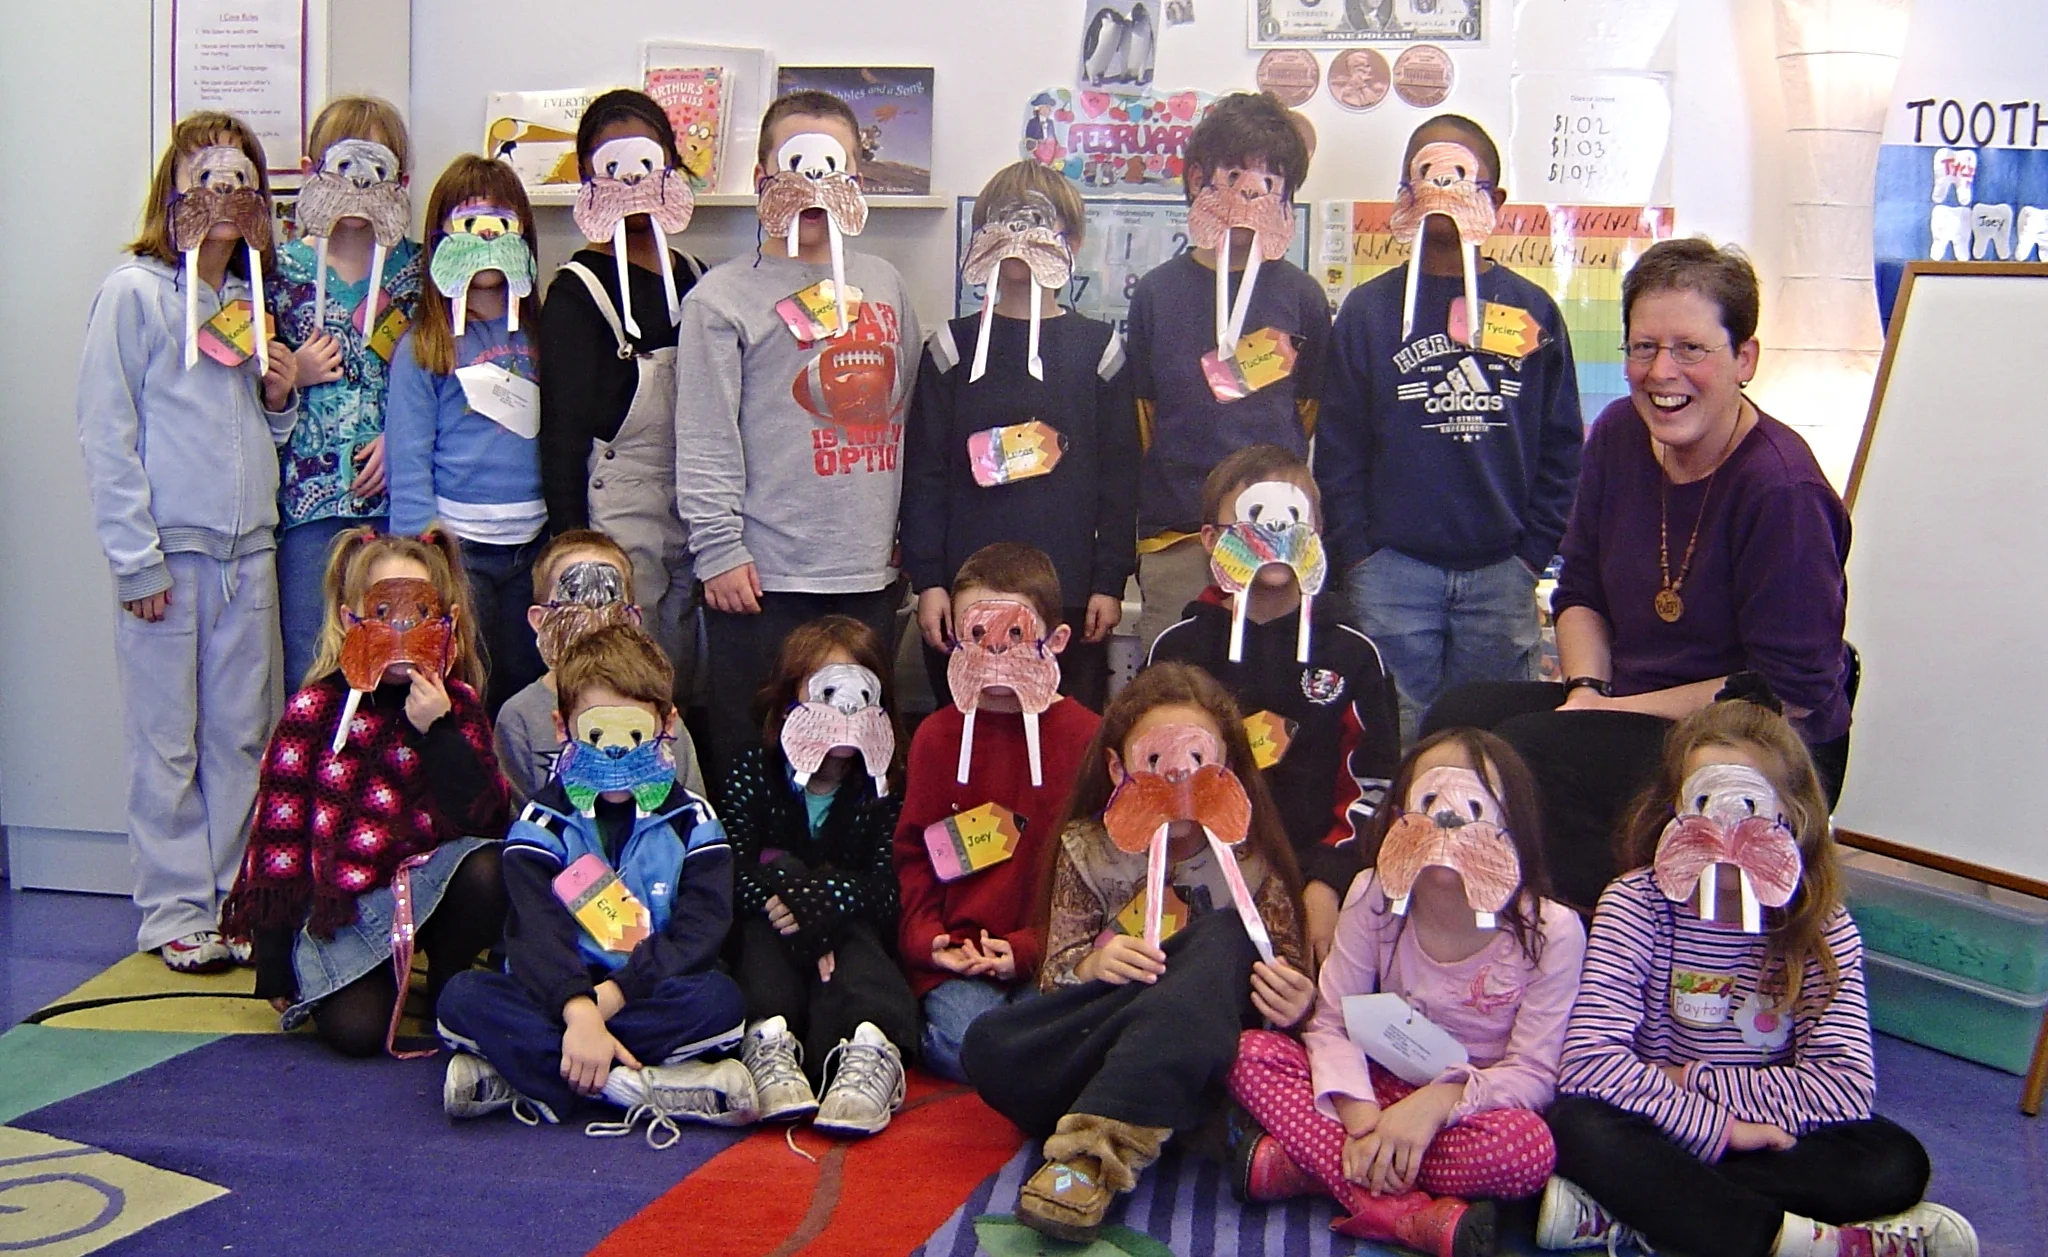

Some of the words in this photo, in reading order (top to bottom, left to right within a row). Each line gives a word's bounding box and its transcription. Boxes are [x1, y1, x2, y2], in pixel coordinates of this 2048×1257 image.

[1326, 31, 1356, 40] ONE
[1358, 30, 1412, 40] DOLLAR
[868, 84, 886, 94] and
[894, 81, 925, 97] Song
[543, 95, 596, 110] EVERYBO
[681, 95, 703, 107] KISS
[1554, 114, 1610, 135] $1.02
[1906, 98, 2048, 147] TOOTH
[1552, 137, 1605, 158] $1.03
[1979, 215, 2005, 229] Joey
[1073, 275, 1090, 303] 7
[1123, 273, 1139, 300] 8
[1240, 351, 1275, 370] Tucker
[1424, 391, 1505, 414] adidas
[811, 428, 838, 449] IS
[814, 443, 898, 477] OPTIO
[597, 898, 619, 921] Erik
[1675, 996, 1726, 1018] Payton
